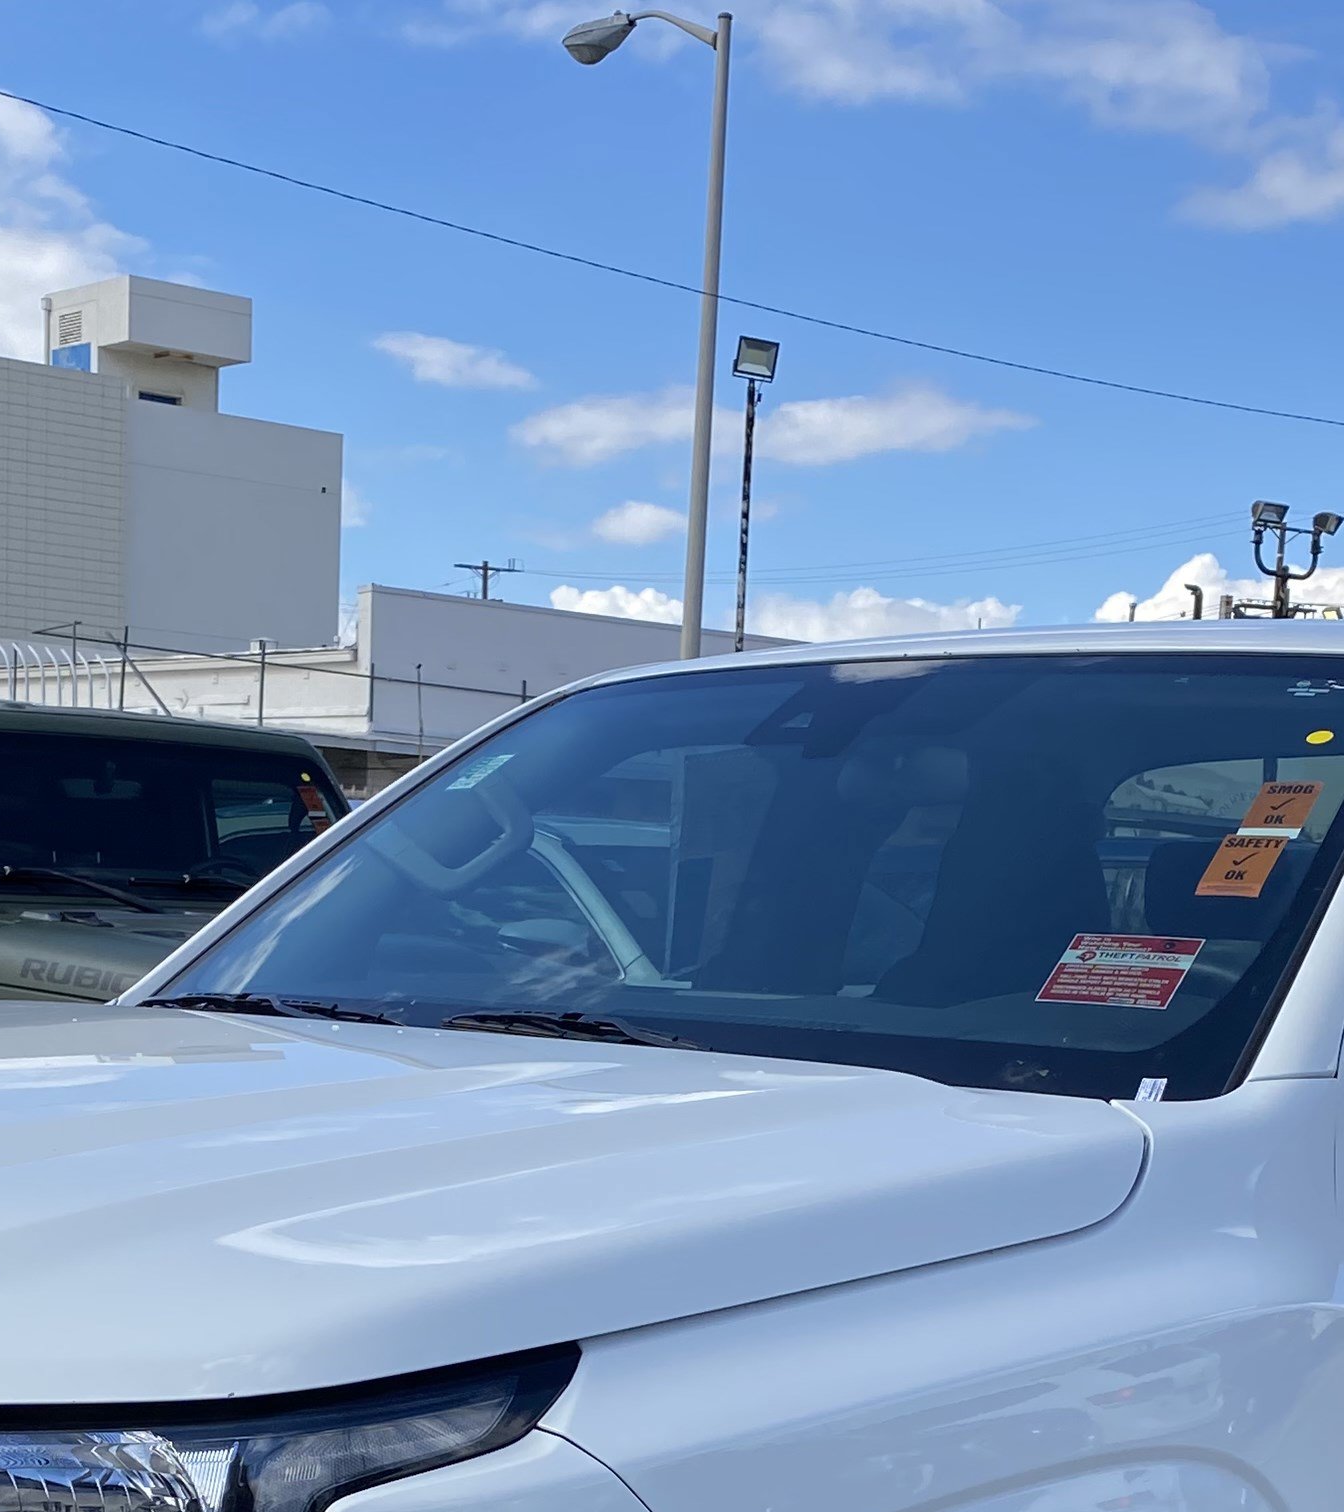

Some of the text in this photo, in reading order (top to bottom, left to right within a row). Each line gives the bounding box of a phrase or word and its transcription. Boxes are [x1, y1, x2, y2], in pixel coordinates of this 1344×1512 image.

[1267, 783, 1315, 795] SMOG
[1263, 814, 1287, 825] OK
[1224, 838, 1285, 849] SAFETY
[1224, 870, 1248, 881] OK
